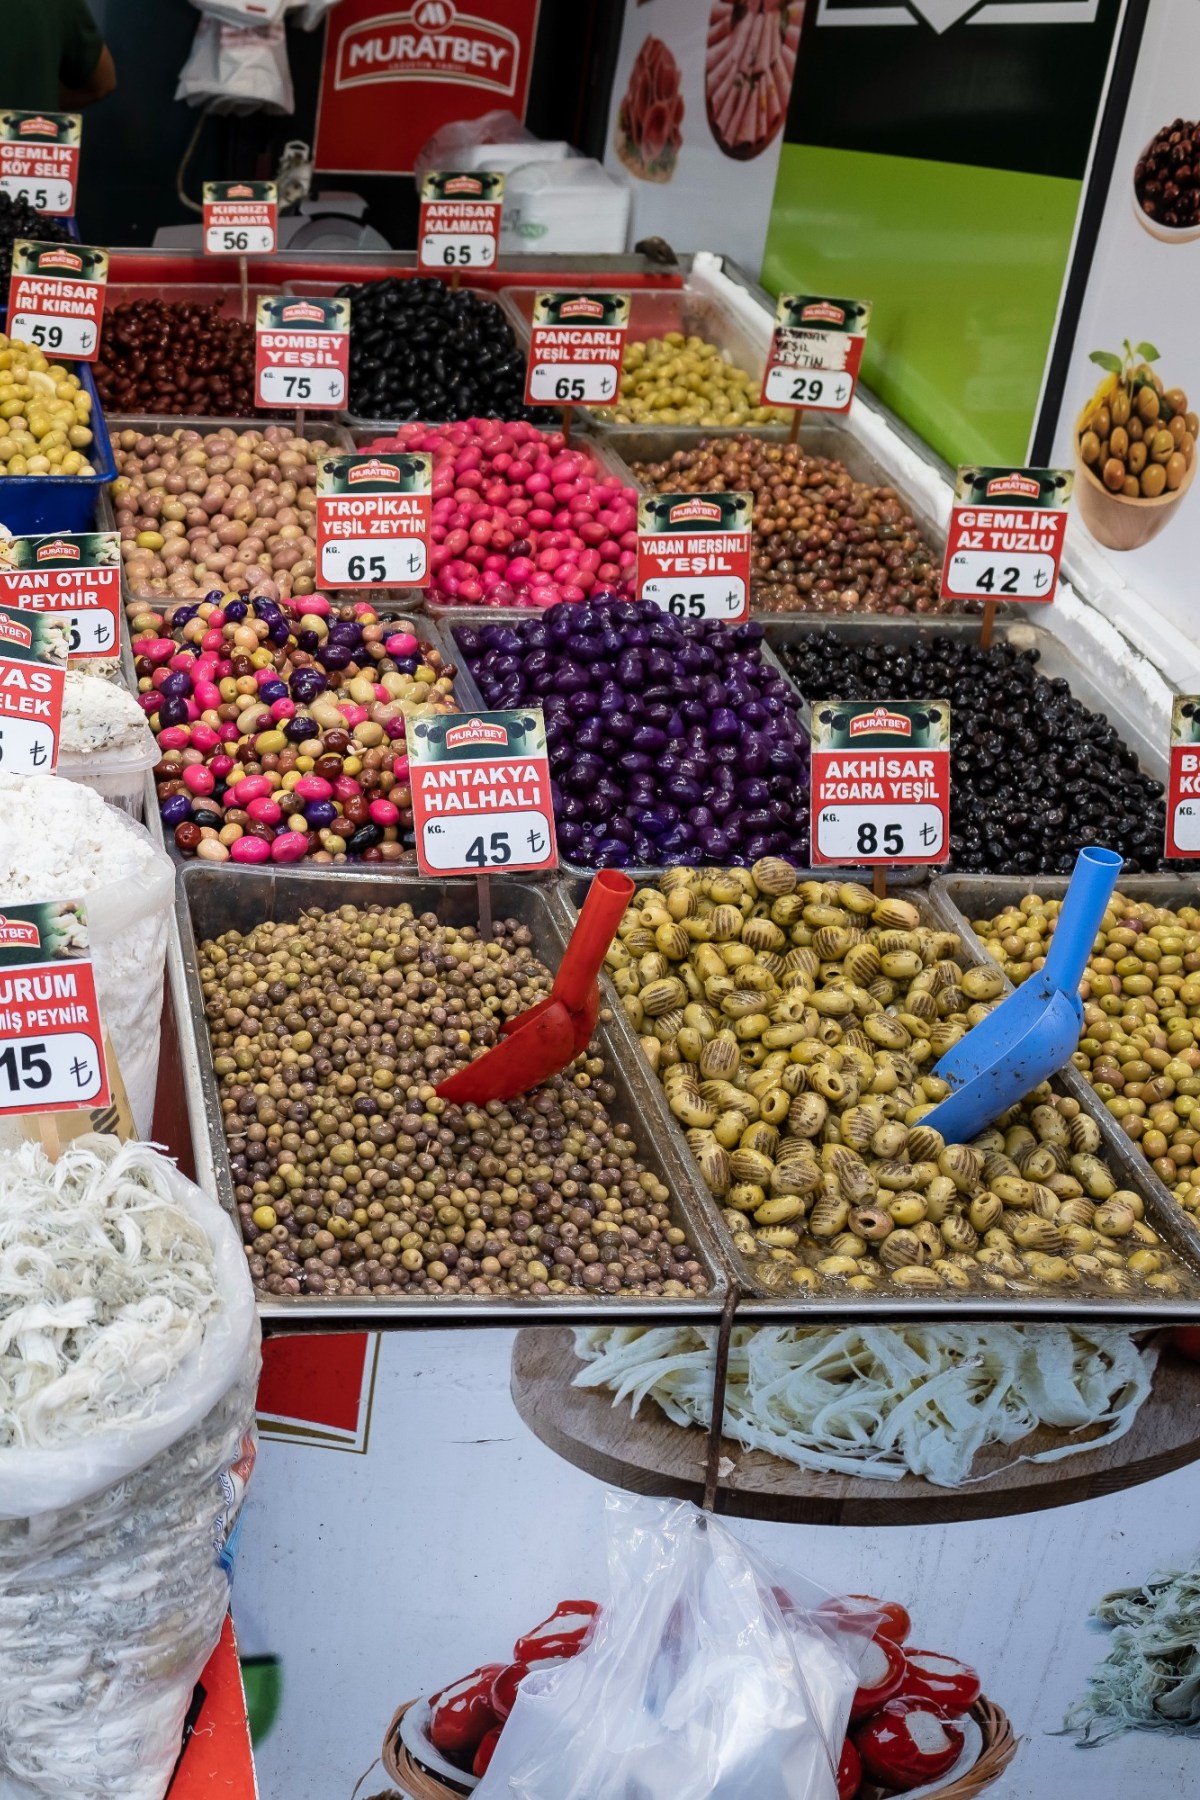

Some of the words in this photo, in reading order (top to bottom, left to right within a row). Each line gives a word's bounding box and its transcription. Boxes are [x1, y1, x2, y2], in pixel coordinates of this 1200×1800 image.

[349, 35, 505, 71] MURATBEY
[0, 144, 73, 162] GEMLİK
[2, 159, 31, 175] KÖY
[35, 163, 69, 178] SELE
[210, 215, 270, 225] KALAMATA
[426, 203, 495, 218] AKHİSAR
[425, 219, 494, 233] KALAMATA
[224, 232, 249, 250] 56
[443, 245, 471, 265] 65
[18, 280, 98, 300] AKHİSAR
[16, 295, 38, 309] İRİ
[43, 298, 95, 315] KIRMA
[31, 325, 63, 347] 59
[261, 335, 343, 350] BOMBEY
[536, 331, 620, 346] PANCARLI
[267, 349, 339, 367] YEŞİL
[534, 346, 569, 363] YEŞİL
[574, 346, 620, 361] ZEYTİN
[283, 376, 311, 398] 75
[555, 378, 585, 400] 65
[791, 379, 823, 401] 29
[324, 498, 423, 517] TROPİKAL
[322, 520, 367, 538] YEŞİL
[370, 517, 426, 535] ZEYTİN
[958, 510, 1058, 530] GEMLİK
[642, 539, 684, 555] YABAN
[687, 535, 748, 554] MERSİNLİ
[957, 531, 984, 549] AZ
[990, 533, 1055, 551] TUZLU
[348, 556, 386, 582] 65
[657, 556, 732, 575] YEŞİL
[4, 573, 49, 590] VAN
[56, 571, 113, 587] OTLU
[976, 567, 1020, 594] 42
[18, 590, 98, 609] PEYNİR
[668, 594, 706, 619] 65
[853, 718, 907, 731] MURATBEY
[449, 727, 503, 743] MURATBEY
[421, 765, 541, 789] ANTAKYA
[825, 756, 934, 778] AKHİSAR
[424, 788, 541, 812] HALHALI
[819, 782, 884, 800] IZGARA
[890, 781, 940, 802] YEŞİL
[822, 813, 839, 822] KG.
[856, 822, 904, 855] 85
[427, 825, 445, 834] KG.
[465, 832, 511, 867] 45
[27, 1003, 89, 1029] PEYNİR
